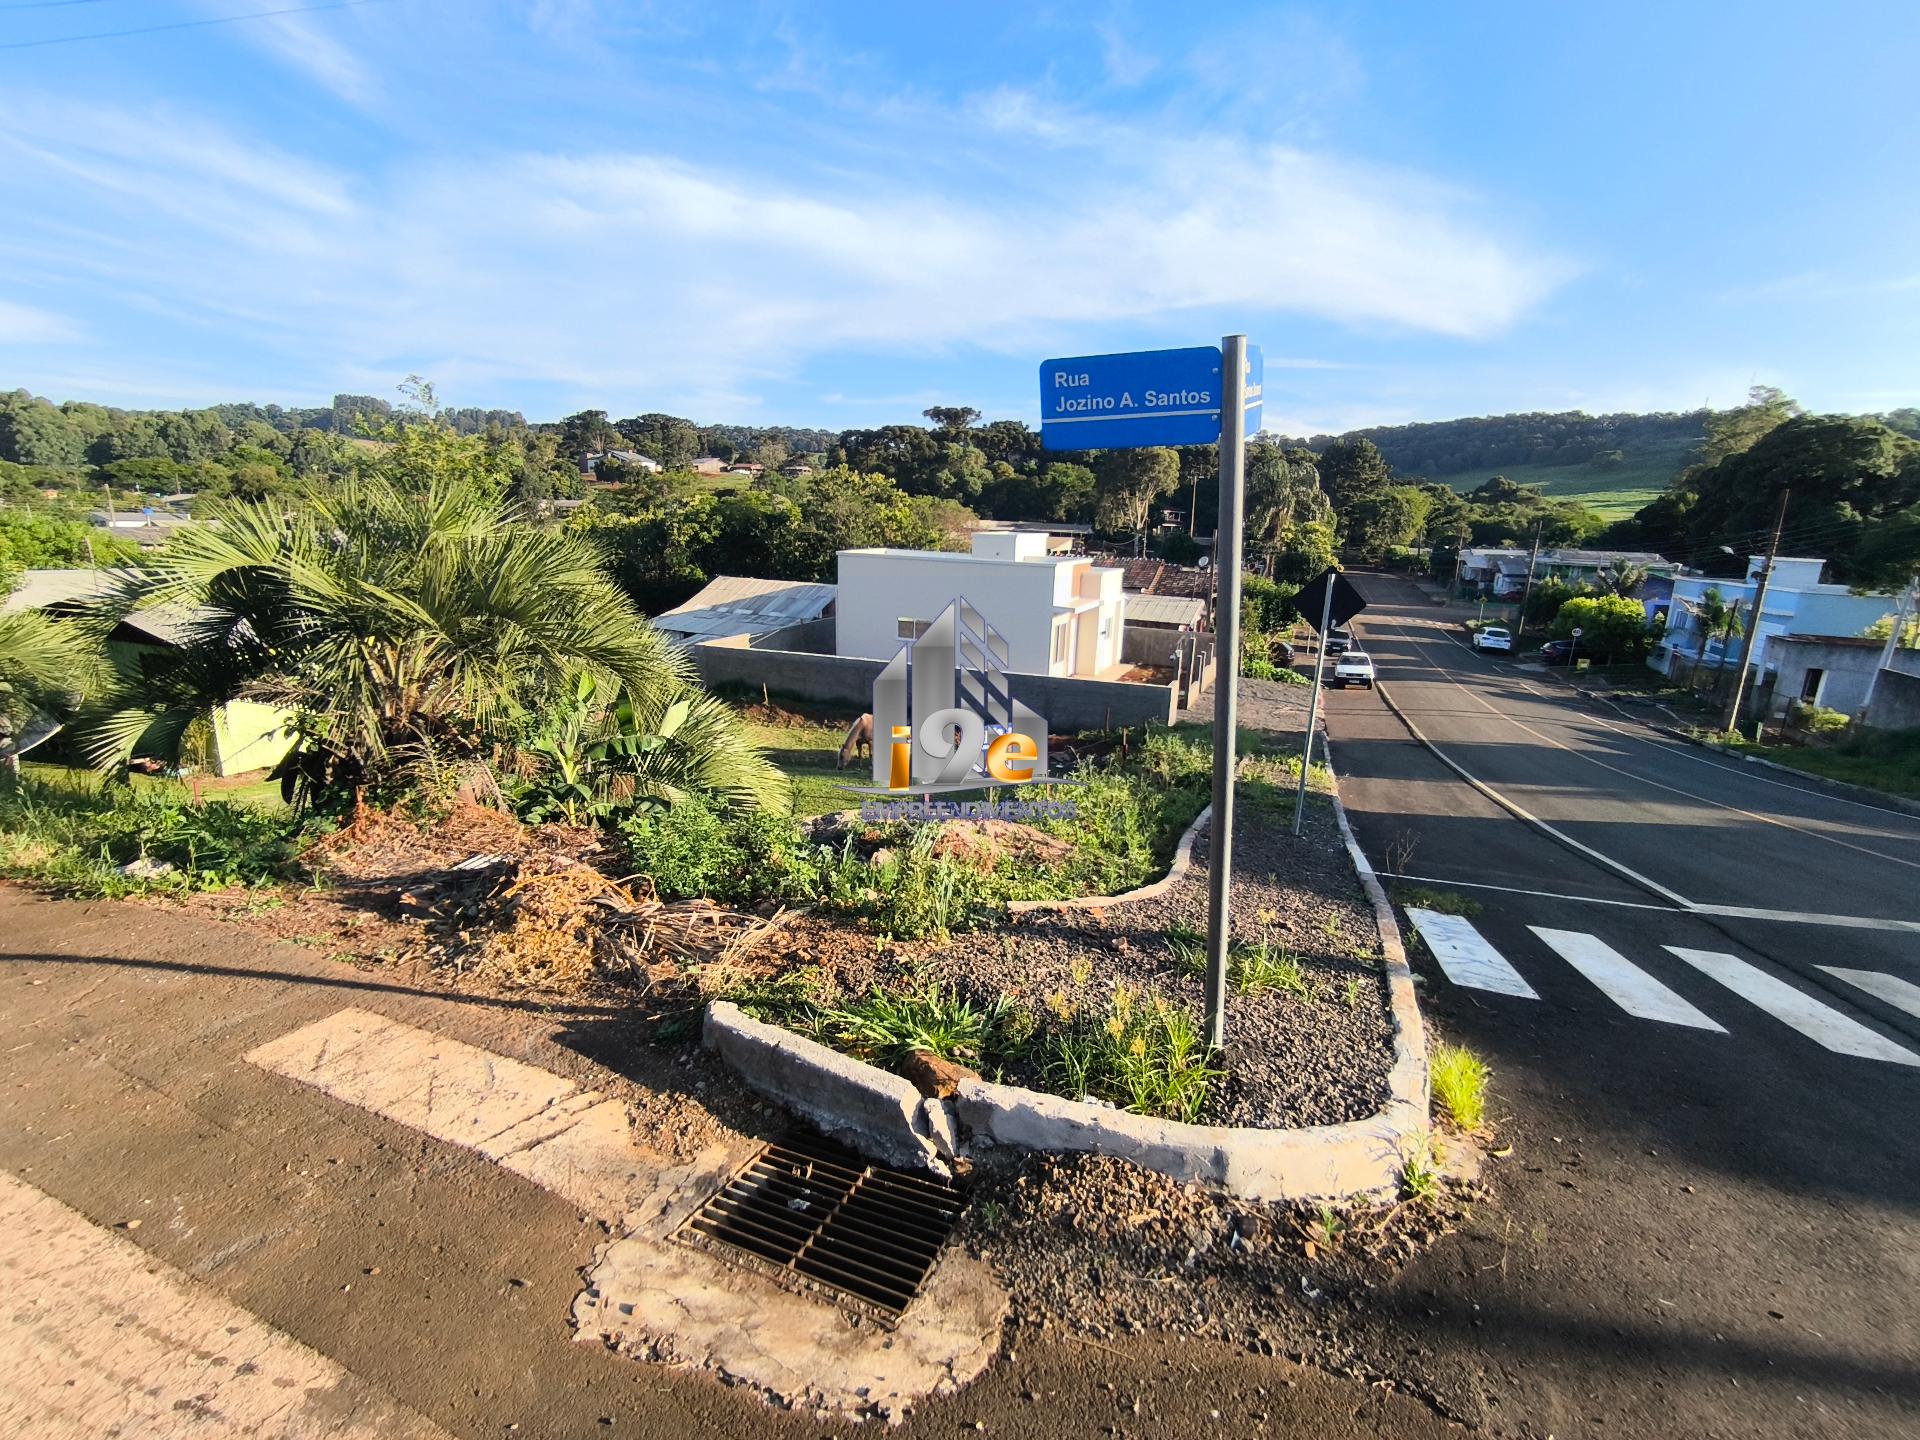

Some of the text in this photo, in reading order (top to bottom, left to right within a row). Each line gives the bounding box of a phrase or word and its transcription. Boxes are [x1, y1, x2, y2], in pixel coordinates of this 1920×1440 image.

[1055, 372, 1090, 388] Rua
[1055, 389, 1211, 412] Jozino A. Santos
